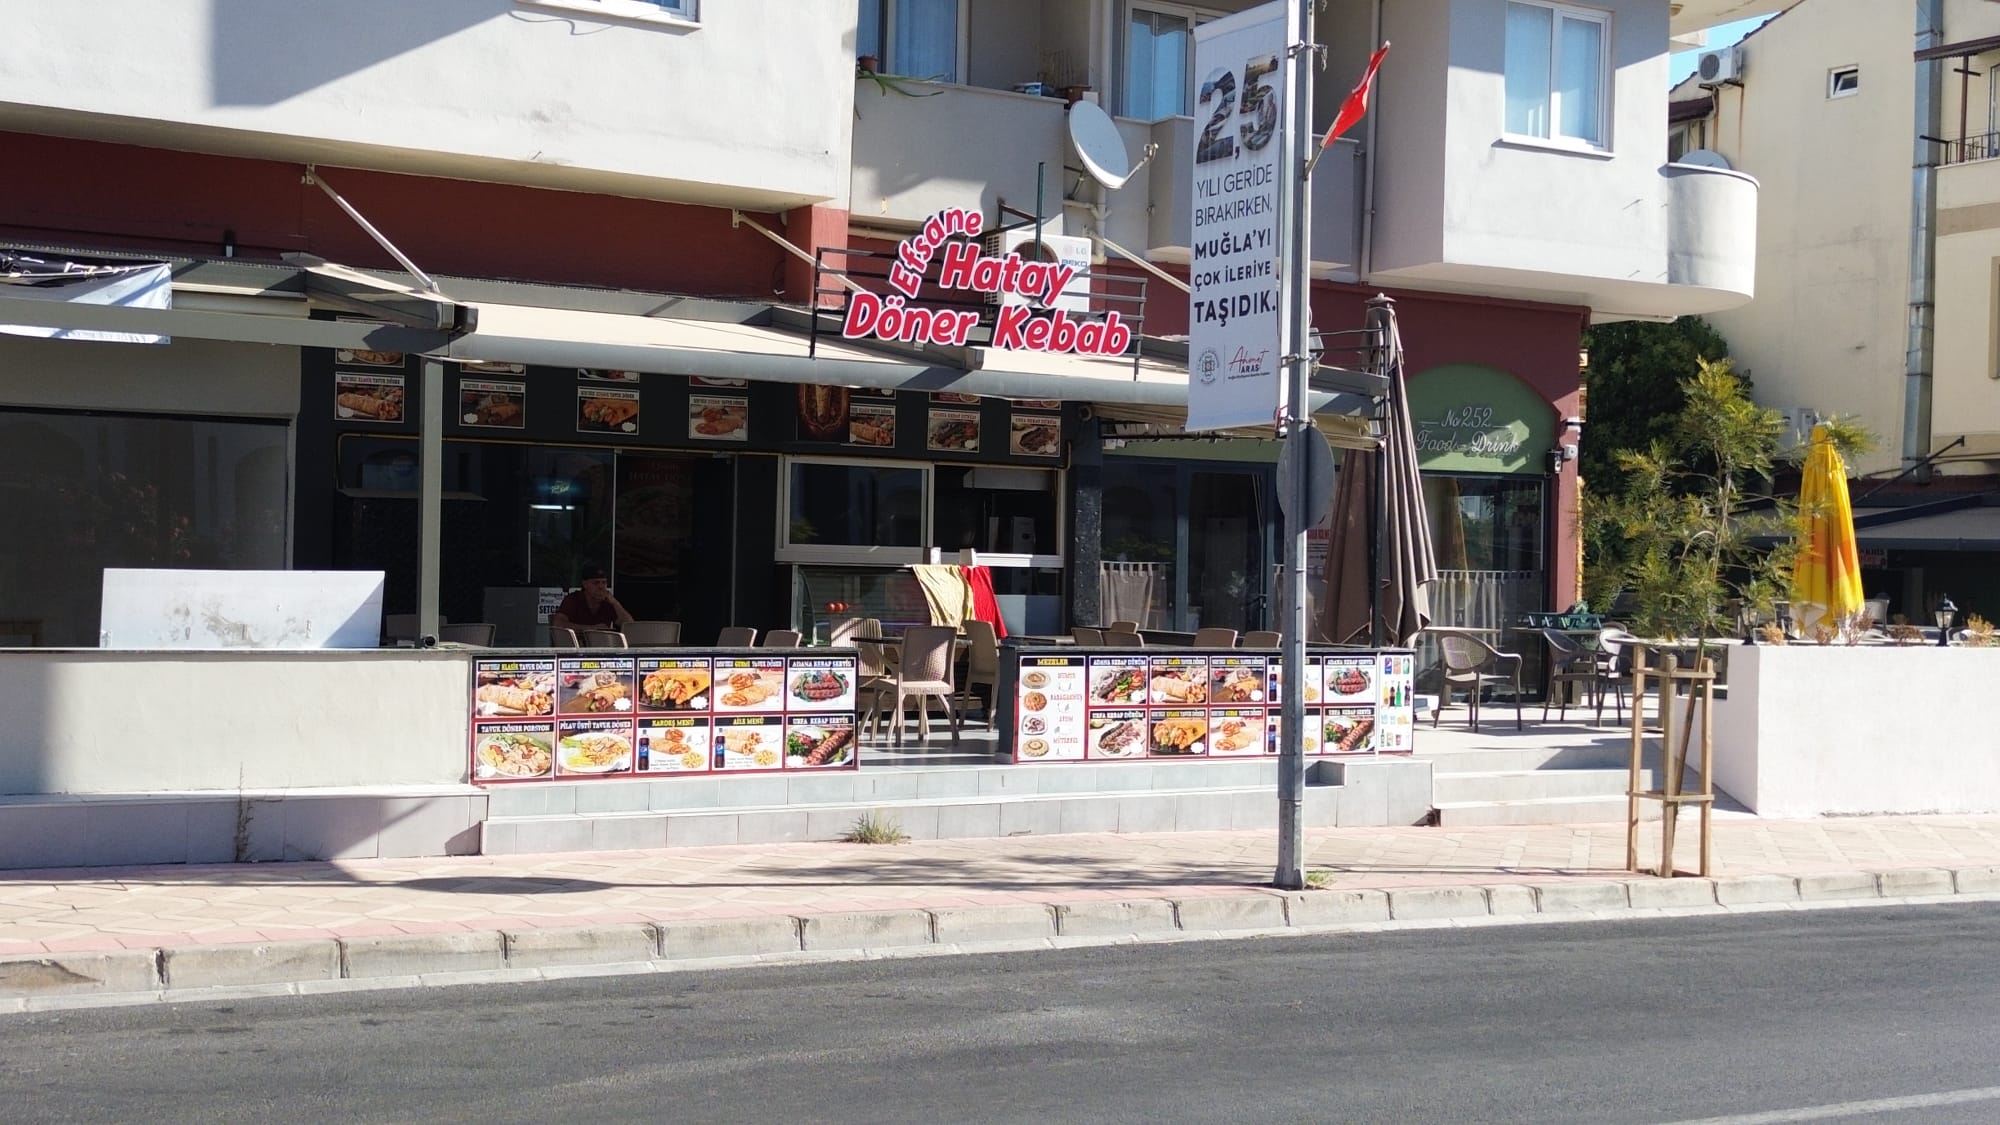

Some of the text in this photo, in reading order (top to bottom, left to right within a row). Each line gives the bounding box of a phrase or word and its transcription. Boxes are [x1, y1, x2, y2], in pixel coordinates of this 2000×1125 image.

[1197, 164, 1272, 199] YILI GERİDE
[1196, 193, 1272, 227] BIRAKIRKEN,
[890, 209, 982, 298] Efsane
[1195, 228, 1270, 260] MUĞLA'YI
[940, 243, 1073, 306] Hatay
[1195, 260, 1271, 292] ÇOK İLERİYE
[845, 292, 1129, 355] Döner Kebab
[1194, 290, 1277, 327] TAŞIDIK.
[1240, 363, 1260, 374] ARAS
[1471, 430, 1520, 453] Drink
[792, 660, 813, 668] ADANA
[481, 725, 501, 733] TAVUK
[502, 724, 523, 732] DÖNER
[592, 721, 611, 729] TAVUK
[611, 720, 631, 728] DÖNER
[676, 718, 695, 727] MENÜ
[747, 716, 764, 725] MENÜ
